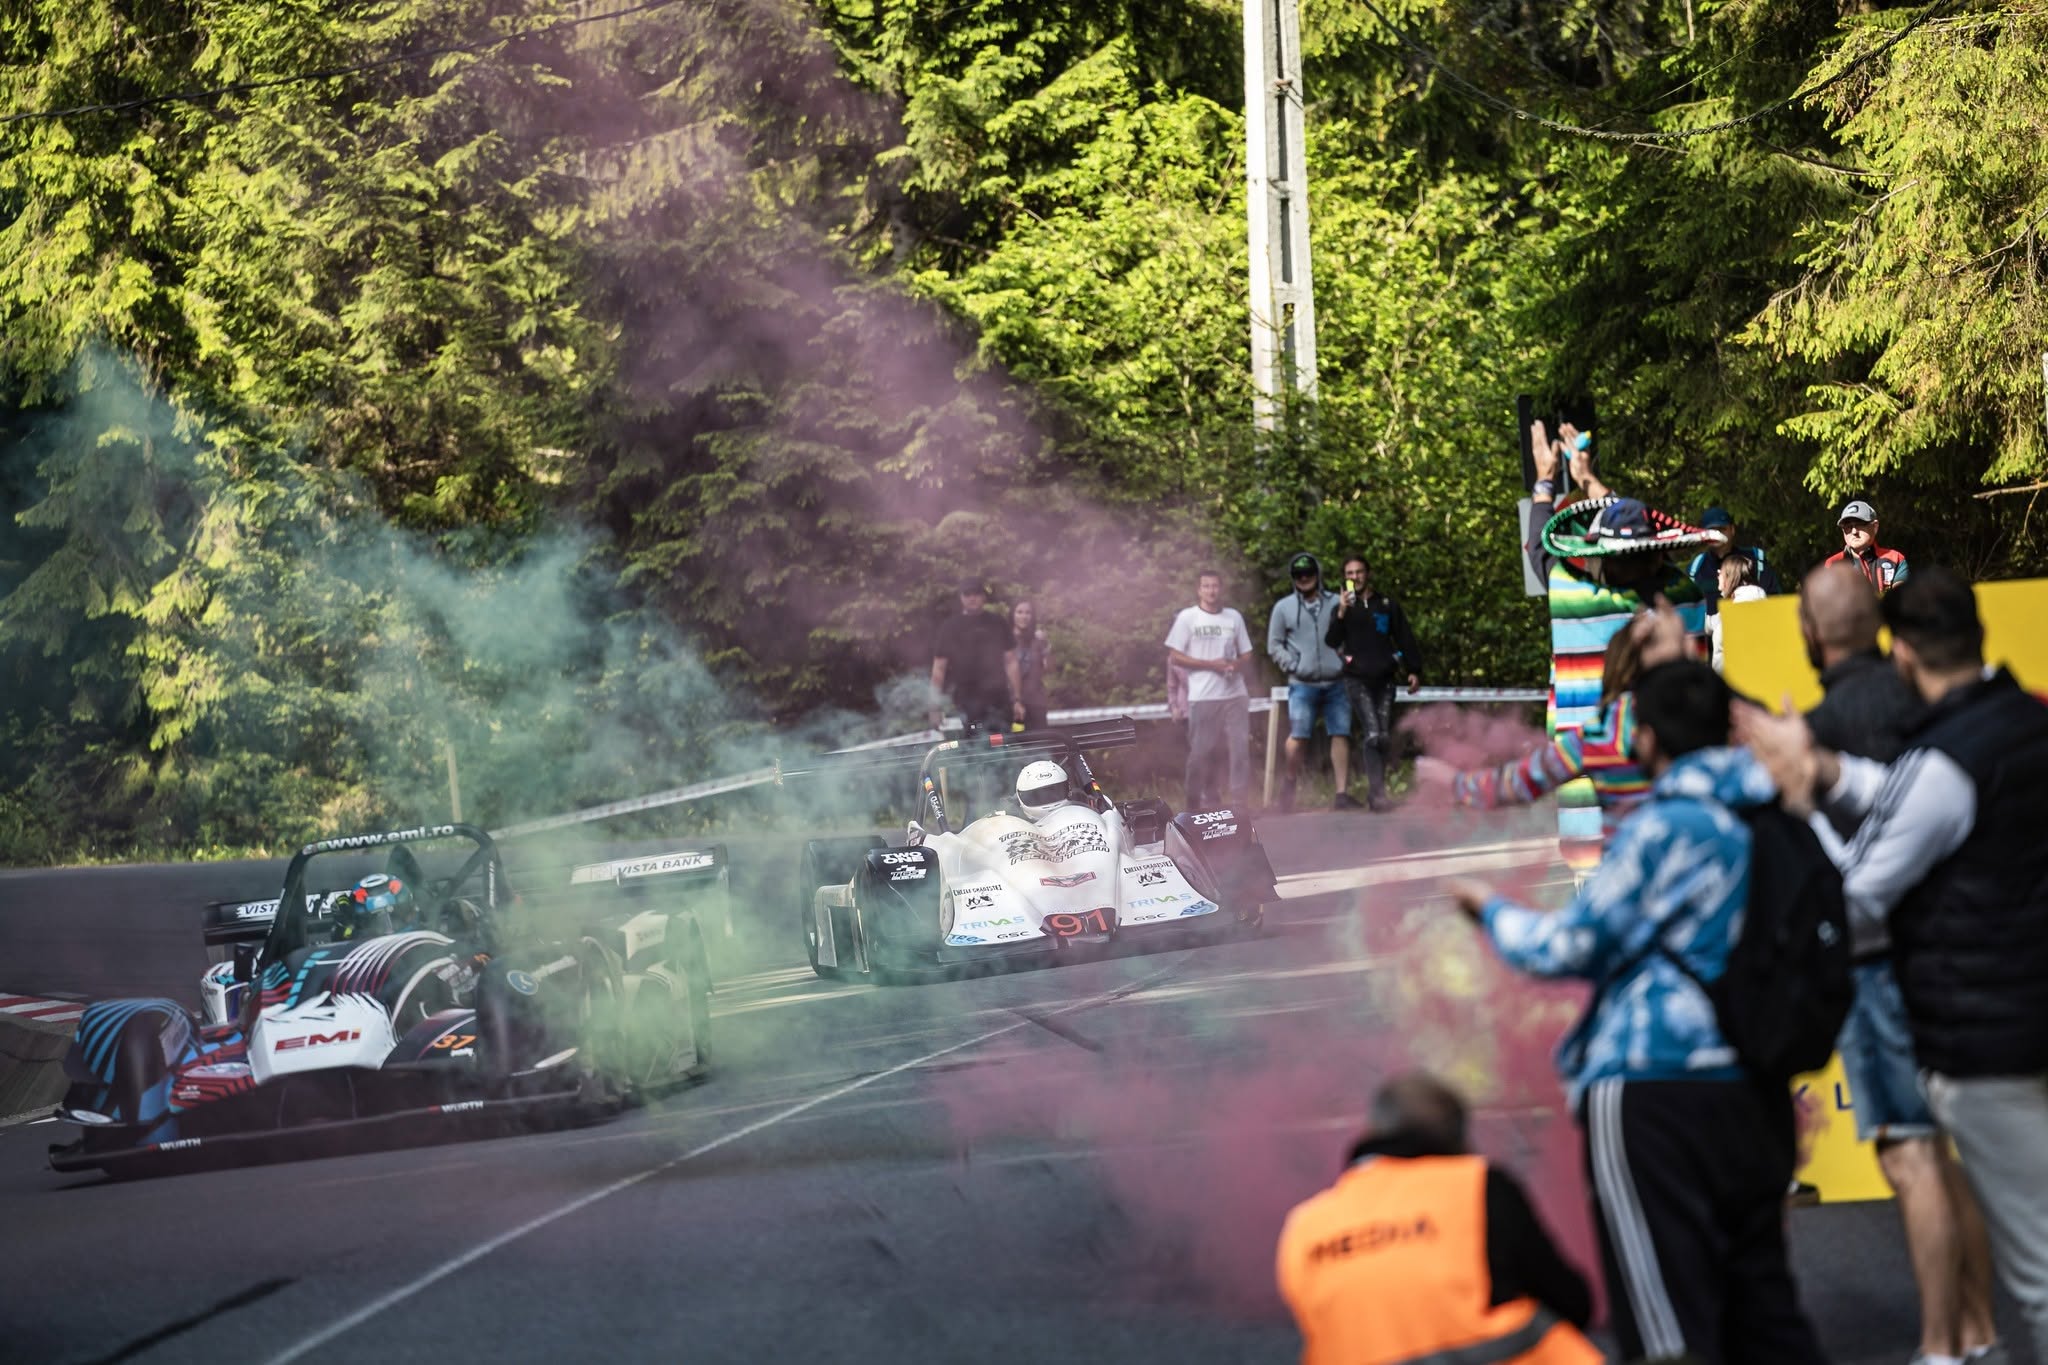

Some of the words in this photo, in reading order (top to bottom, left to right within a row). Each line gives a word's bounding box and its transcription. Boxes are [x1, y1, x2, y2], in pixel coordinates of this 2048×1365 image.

[1191, 810, 1232, 819] TWO
[1194, 814, 1234, 824] ONE
[326, 825, 454, 849] www.emi.ro
[881, 851, 922, 859] TWO
[883, 856, 925, 864] ONE
[617, 862, 658, 875] VISTA
[662, 855, 702, 870] BANK
[1127, 893, 1192, 908] TRIVAS
[244, 902, 279, 915] VIST
[960, 916, 1025, 929] TRIVAS
[1051, 909, 1108, 936] 91
[1133, 913, 1167, 921] GSC
[996, 931, 1030, 939] GSC
[433, 1034, 476, 1049] 37
